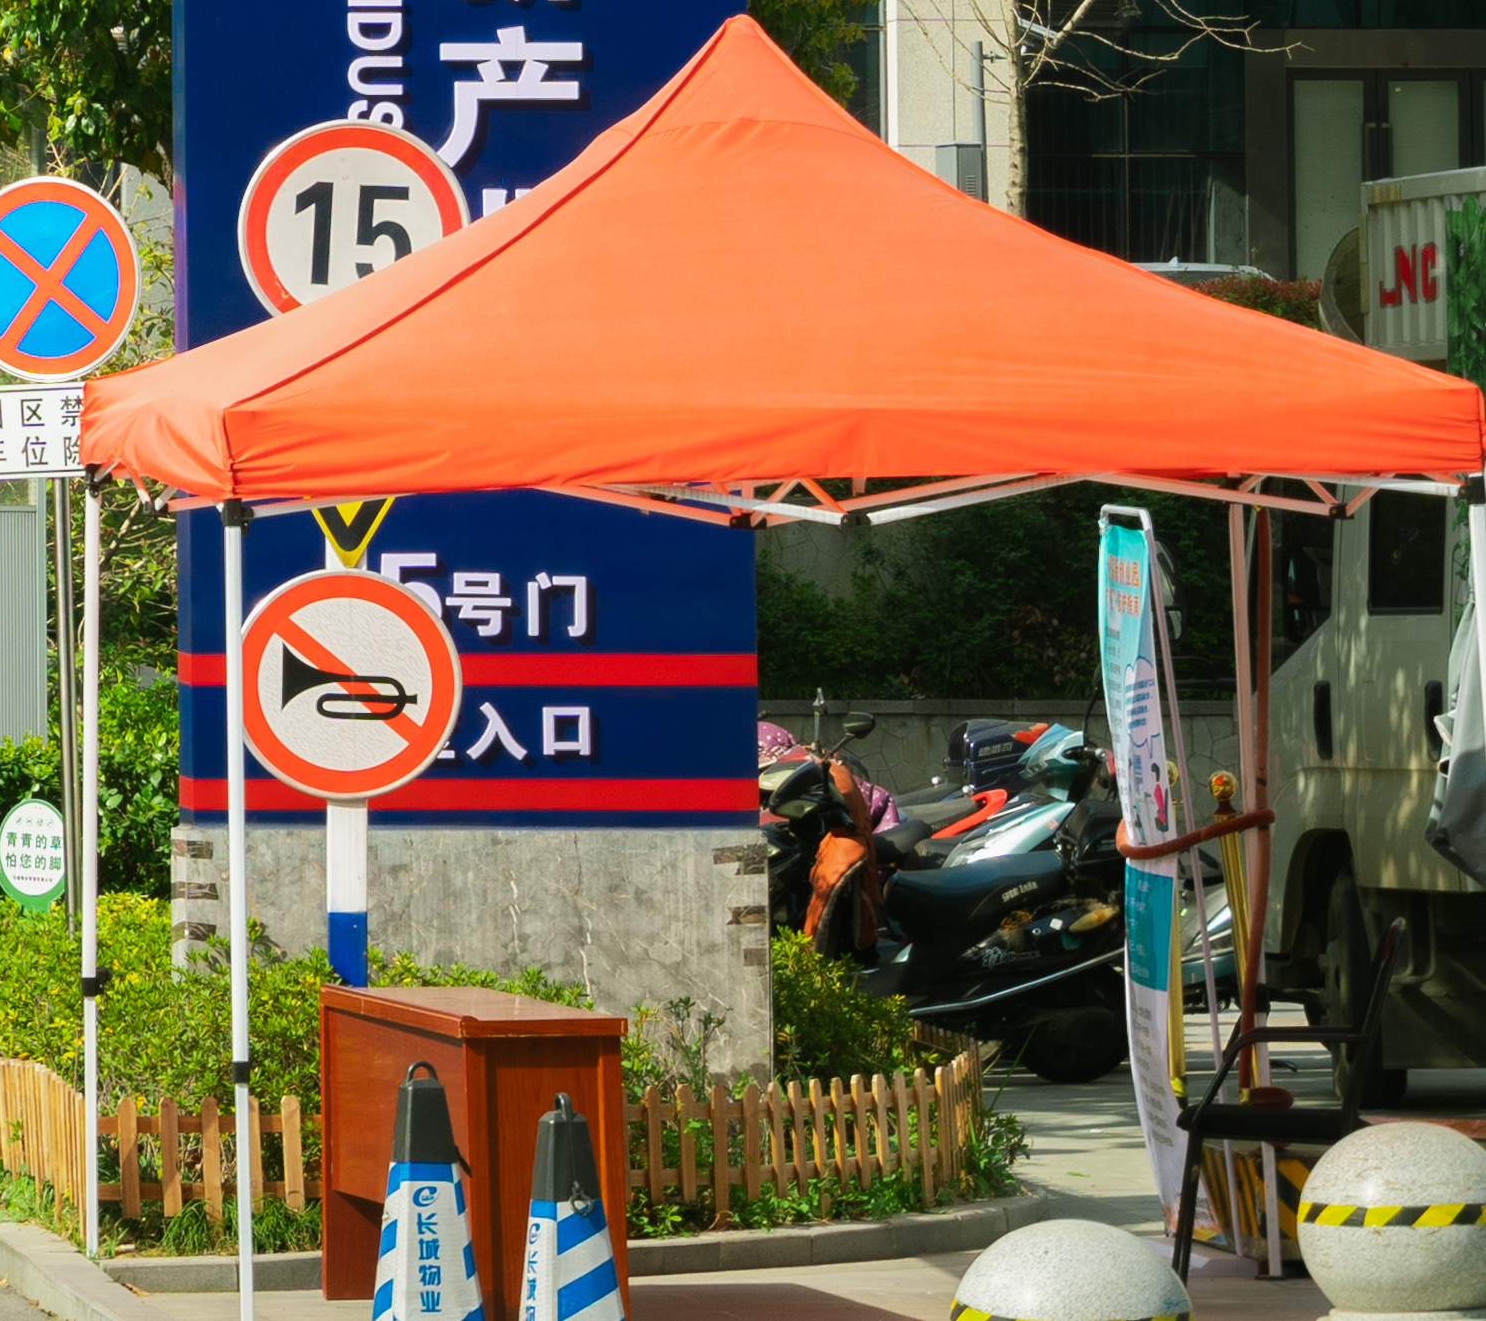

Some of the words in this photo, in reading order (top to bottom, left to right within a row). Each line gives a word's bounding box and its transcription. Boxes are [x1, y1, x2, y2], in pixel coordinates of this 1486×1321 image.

[293, 180, 412, 285] 15
[380, 552, 588, 638] 5号门
[436, 702, 591, 761] 入口
[5, 852, 62, 871] 怕您的脚
[6, 831, 63, 850] 青青的草
[416, 1212, 442, 1313] 长城物业
